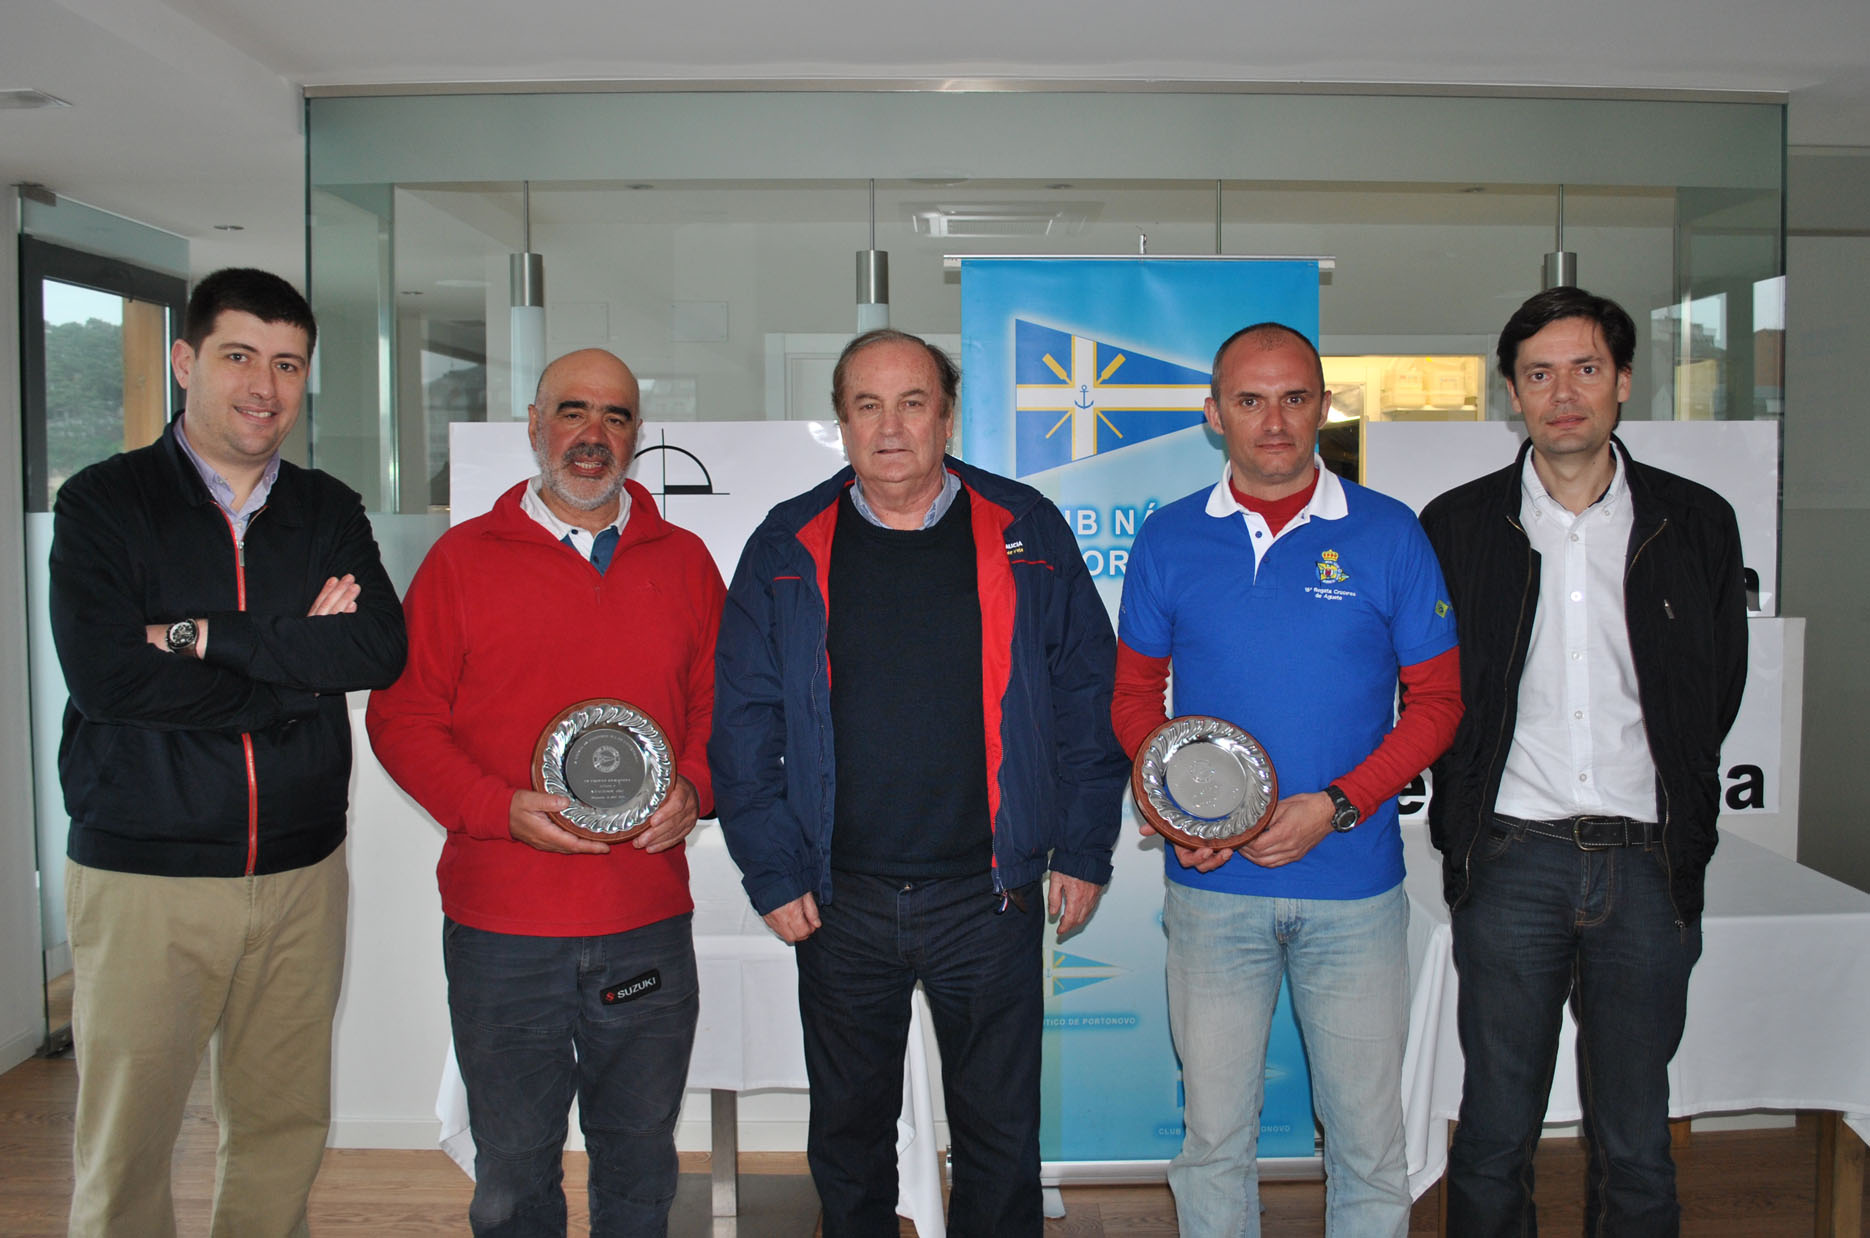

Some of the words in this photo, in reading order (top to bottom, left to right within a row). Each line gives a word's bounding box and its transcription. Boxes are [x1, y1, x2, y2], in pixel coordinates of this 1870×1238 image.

[617, 976, 657, 999] SUZUKI
[1068, 1017, 1080, 1026] DE
[1082, 1016, 1136, 1026] PORTONOVO
[1158, 1127, 1182, 1135] CLUB
